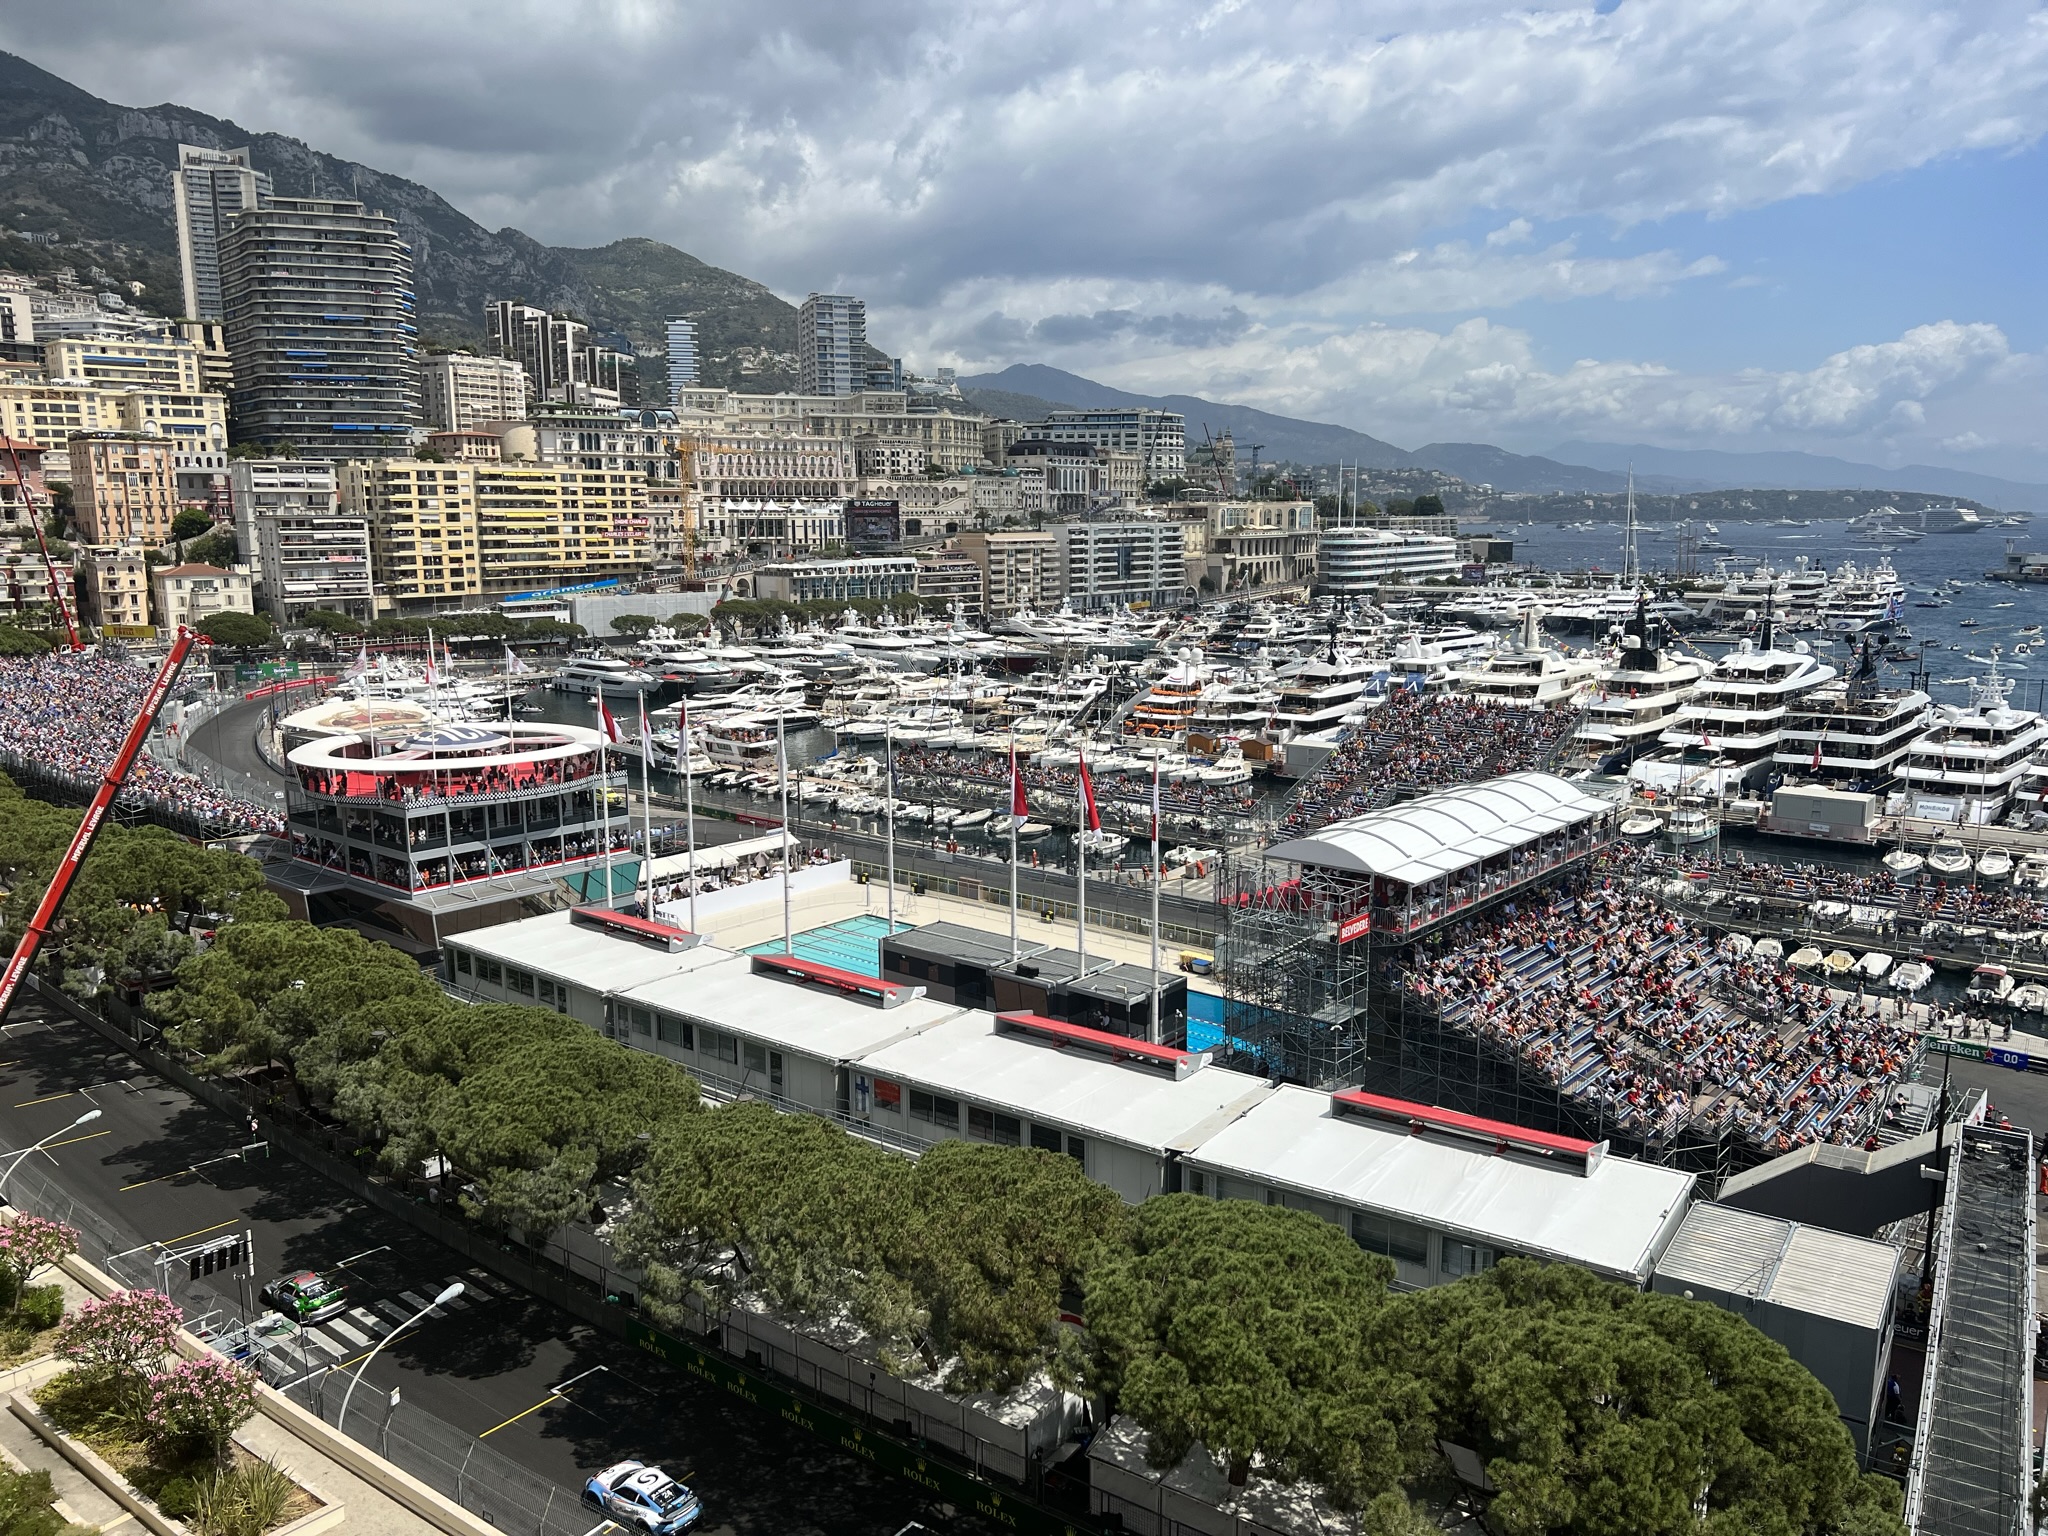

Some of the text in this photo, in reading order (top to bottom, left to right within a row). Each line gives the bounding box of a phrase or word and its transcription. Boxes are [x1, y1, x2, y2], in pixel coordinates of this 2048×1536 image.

[531, 583, 594, 597] aramco
[70, 805, 105, 862] IMPERIAL LEVAGE
[1341, 917, 1369, 939] BELVEDERE
[9, 956, 28, 982] LEVAGE
[1927, 1040, 1980, 1057] eineken
[1893, 1323, 1924, 1337] euer
[640, 1338, 667, 1359] ROLEX
[687, 1362, 716, 1383] ROLEX
[727, 1381, 757, 1403] ROLEX
[781, 1408, 814, 1431] ROLEX
[841, 1436, 876, 1460] ROLEX
[903, 1466, 940, 1491] ROLEX
[976, 1500, 1016, 1527] ROLEX
